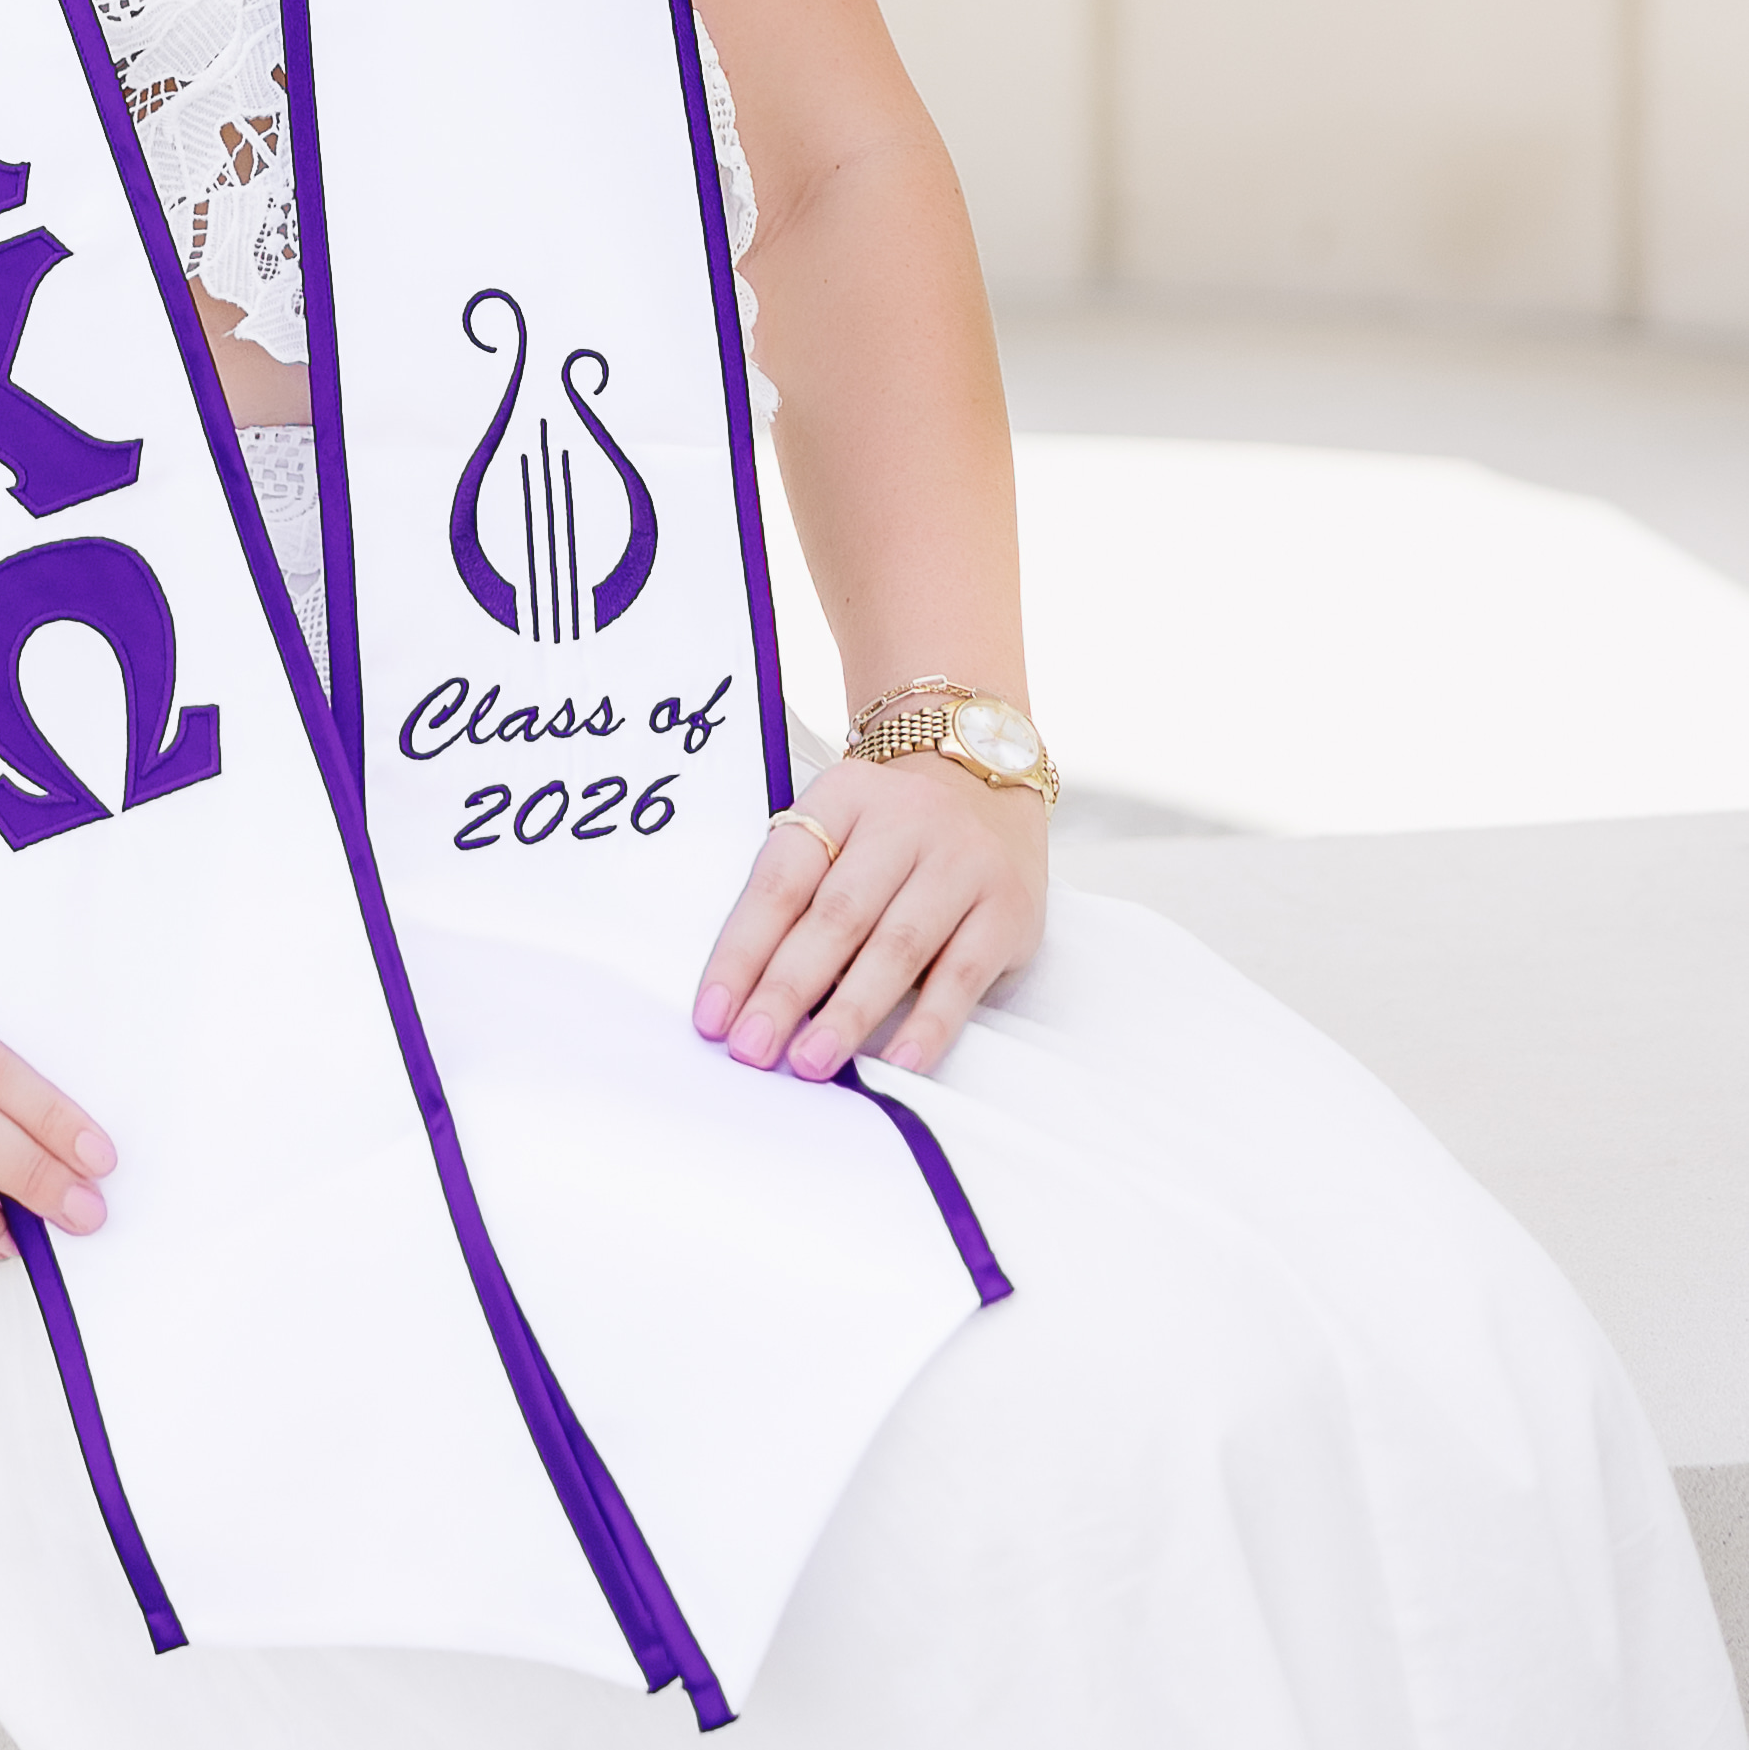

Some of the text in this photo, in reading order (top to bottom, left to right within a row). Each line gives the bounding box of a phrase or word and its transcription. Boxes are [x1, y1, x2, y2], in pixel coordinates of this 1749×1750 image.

[399, 675, 732, 760] Class of
[454, 774, 680, 850] 2026
